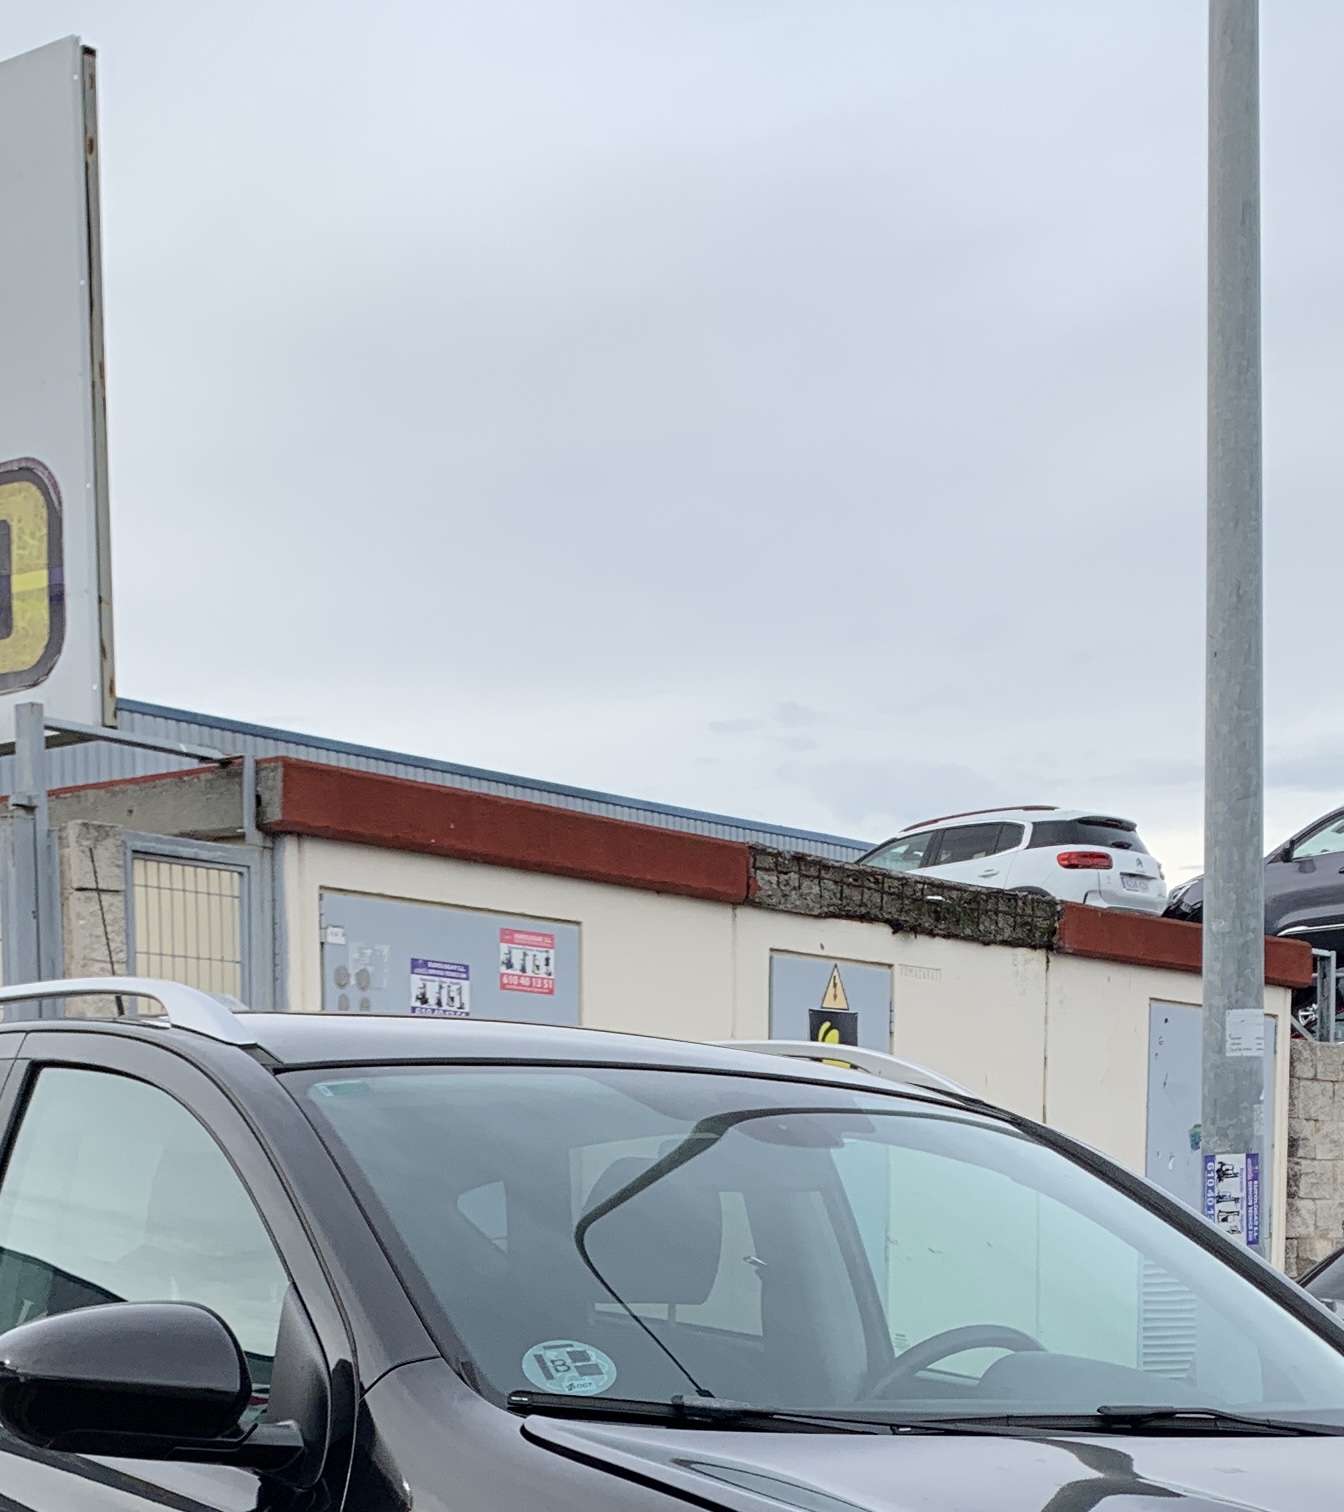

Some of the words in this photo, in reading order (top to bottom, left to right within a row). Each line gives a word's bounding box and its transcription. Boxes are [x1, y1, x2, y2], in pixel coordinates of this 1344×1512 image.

[1206, 1161, 1215, 1187] 610
[1206, 1188, 1215, 1206] 40
[550, 1358, 571, 1373] B
